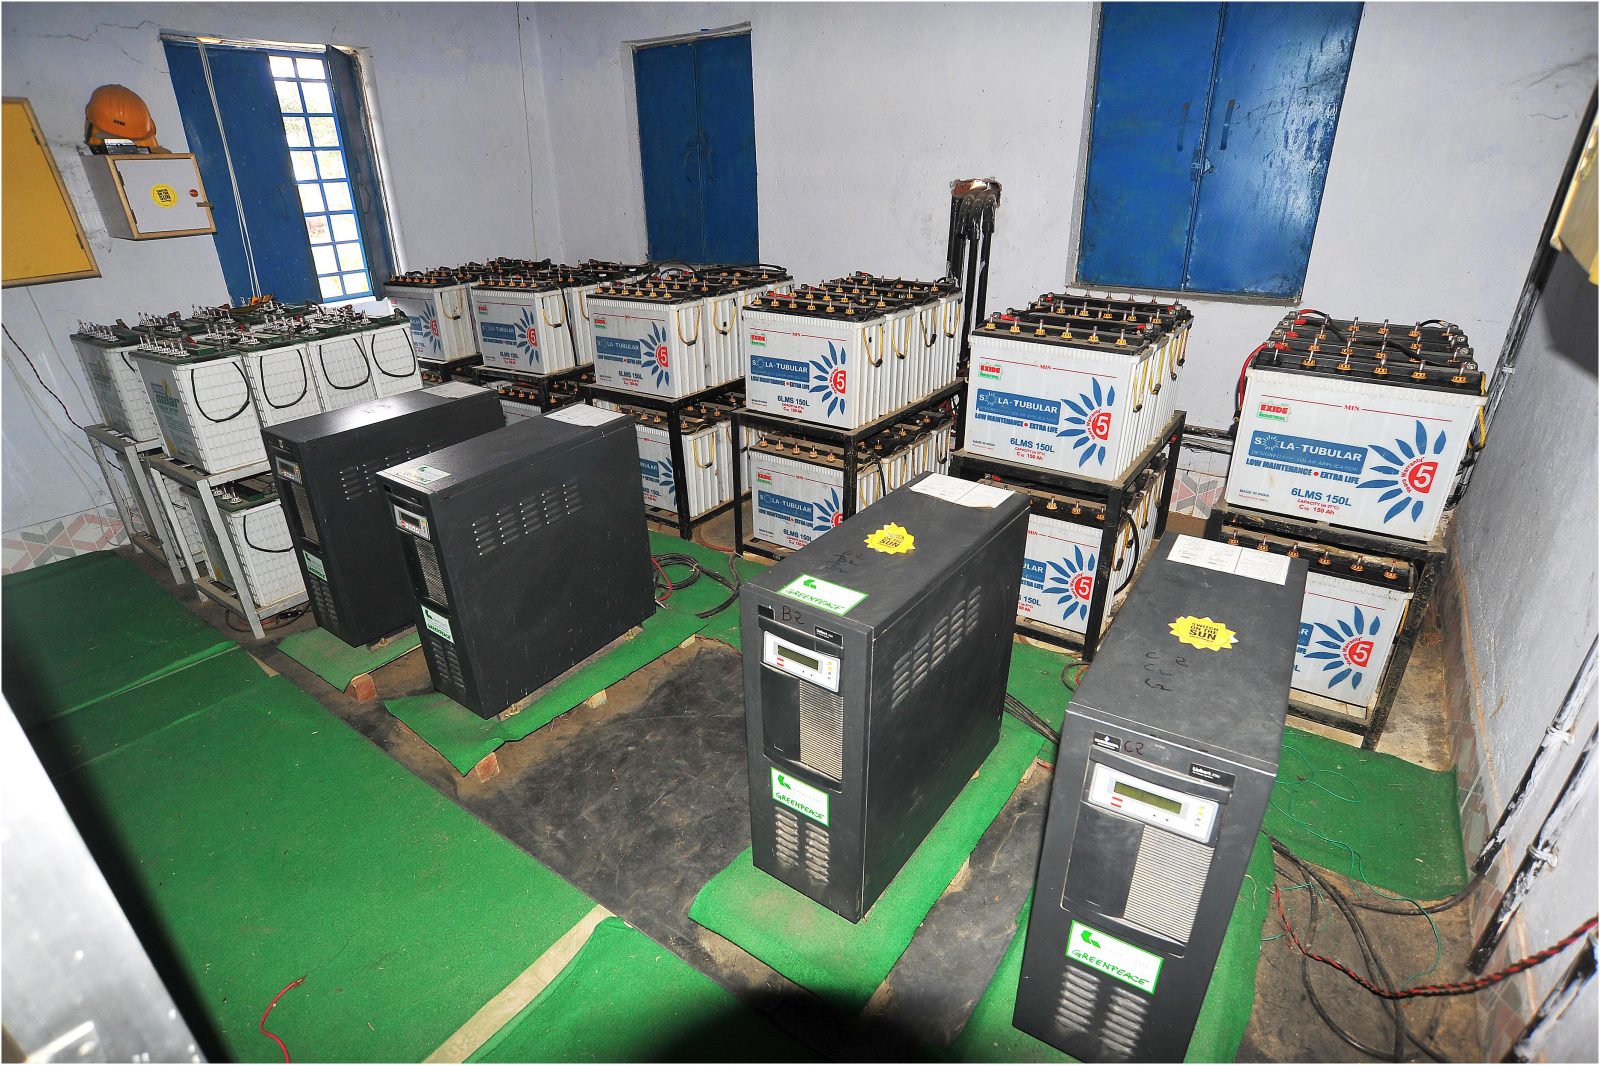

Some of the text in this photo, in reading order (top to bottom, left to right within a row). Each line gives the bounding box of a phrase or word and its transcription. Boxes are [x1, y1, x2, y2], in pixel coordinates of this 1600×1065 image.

[660, 349, 667, 364] 5
[836, 373, 845, 390] 5
[777, 395, 794, 403] 6LMS
[795, 398, 810, 407] 150L
[1260, 403, 1289, 414] EXIDE
[1095, 415, 1108, 435] 5
[1010, 437, 1055, 453] 6LMS 150L
[1246, 458, 1360, 485] LOW MAINTENANCE EXTRA LIFE
[1413, 465, 1434, 488] 5
[1402, 478, 1412, 493] Years
[1291, 487, 1352, 507] 6LMS 150L
[1297, 498, 1320, 506] CAPACITY
[879, 538, 900, 548] SUN
[1078, 579, 1090, 596] 5
[785, 589, 845, 610] GREENPEACE
[1023, 595, 1041, 606] 150L
[1189, 629, 1216, 640] SUN
[1191, 622, 1219, 632] SWITCH
[1204, 627, 1217, 635] THE
[1353, 643, 1370, 663] 5
[775, 792, 825, 820] GREENPEACE
[1072, 949, 1150, 985] GREENPEACE
